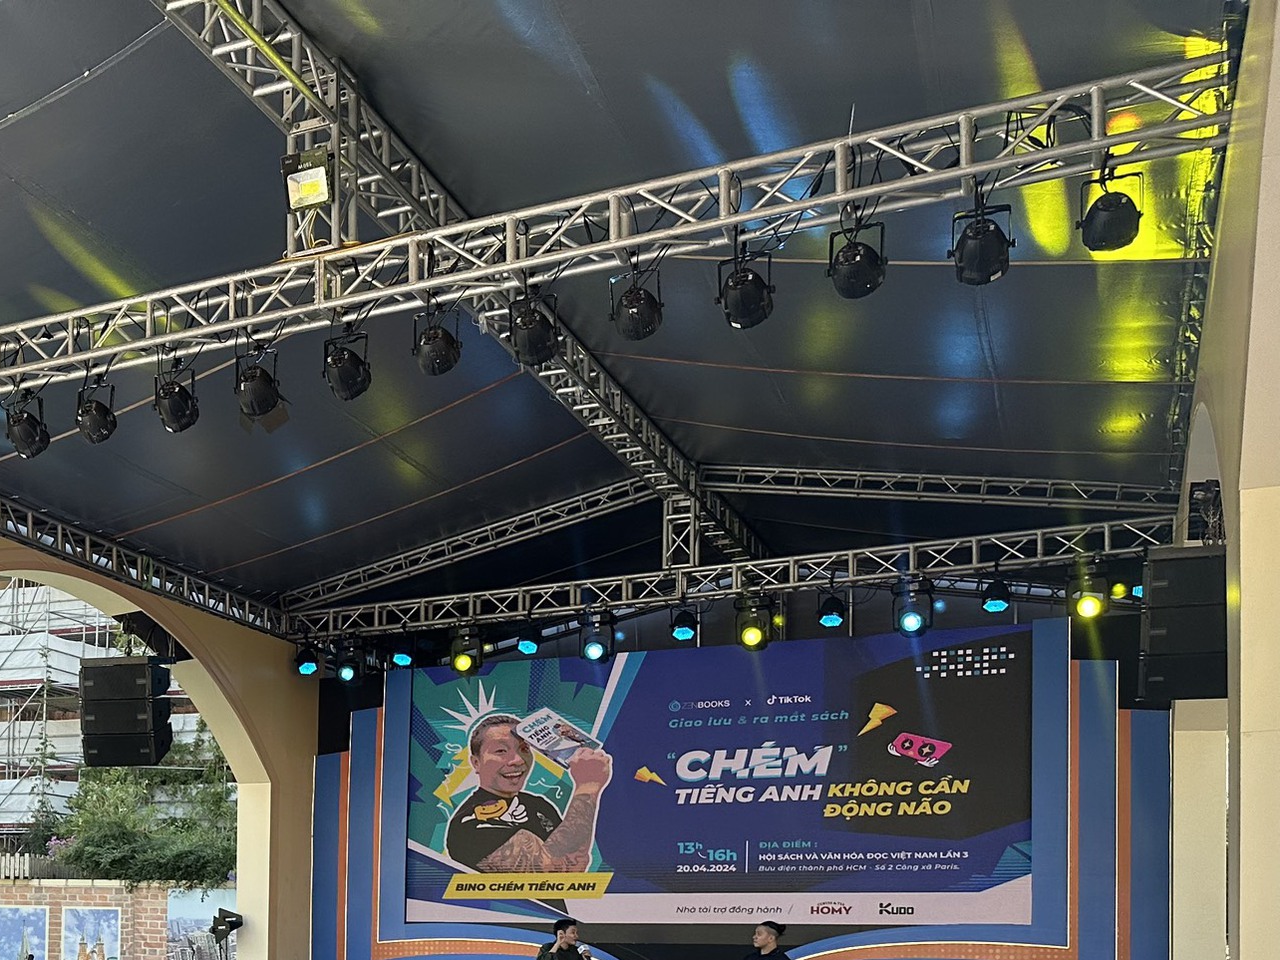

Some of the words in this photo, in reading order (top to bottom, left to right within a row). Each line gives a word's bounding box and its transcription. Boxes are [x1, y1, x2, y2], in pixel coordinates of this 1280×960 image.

[778, 695, 811, 704] TikTok
[669, 719, 703, 728] Giao
[707, 717, 732, 726] lưu
[737, 715, 747, 724] &
[752, 716, 769, 724] ra
[811, 710, 849, 721] sách
[675, 784, 755, 804] TIẾNG
[758, 784, 823, 803] ANH
[827, 779, 913, 797] KHÔNG
[918, 774, 970, 795] CẦN
[823, 800, 892, 820] ĐỘNG
[898, 797, 952, 815] NÃO
[677, 842, 703, 854] 13h
[759, 841, 778, 849] ĐỊA
[782, 839, 811, 848] ĐIỂM
[707, 849, 737, 861] 16h
[758, 853, 776, 861] HỘI
[777, 852, 802, 860] SÁCH
[804, 852, 819, 860] VÀ
[820, 852, 841, 860] VĂN
[843, 852, 865, 860] HÓA
[866, 852, 888, 860] ĐỌC
[891, 851, 913, 860] VIỆT
[676, 864, 737, 872] 20.04.2024
[455, 883, 486, 892] BINO
[489, 881, 525, 892] CHÉM
[527, 880, 565, 891] TIẾNG
[566, 882, 596, 891] ANH
[676, 906, 696, 914] Nhà
[810, 906, 852, 914] HOMY
